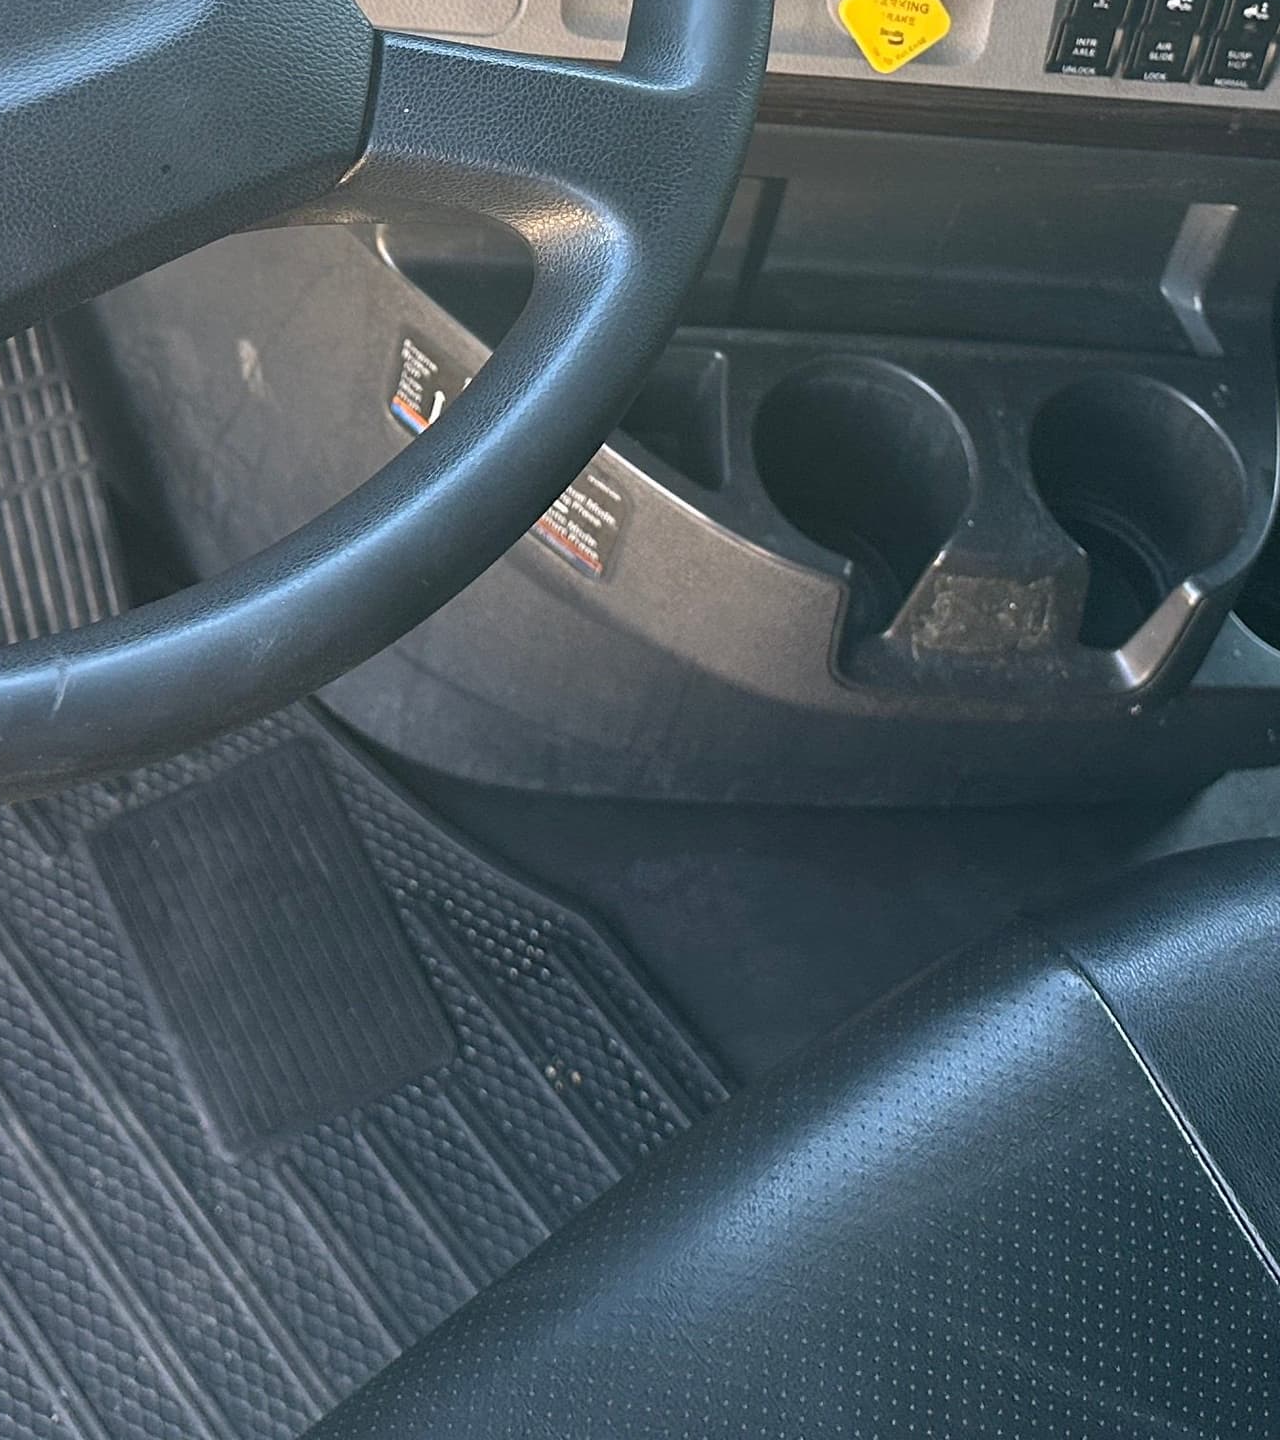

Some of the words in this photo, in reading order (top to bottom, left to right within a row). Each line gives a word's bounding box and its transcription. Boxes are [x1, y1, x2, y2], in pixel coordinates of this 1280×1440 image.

[882, 13, 916, 27] RAKE
[1155, 41, 1173, 51] AIR
[1143, 72, 1167, 81] LOCK
